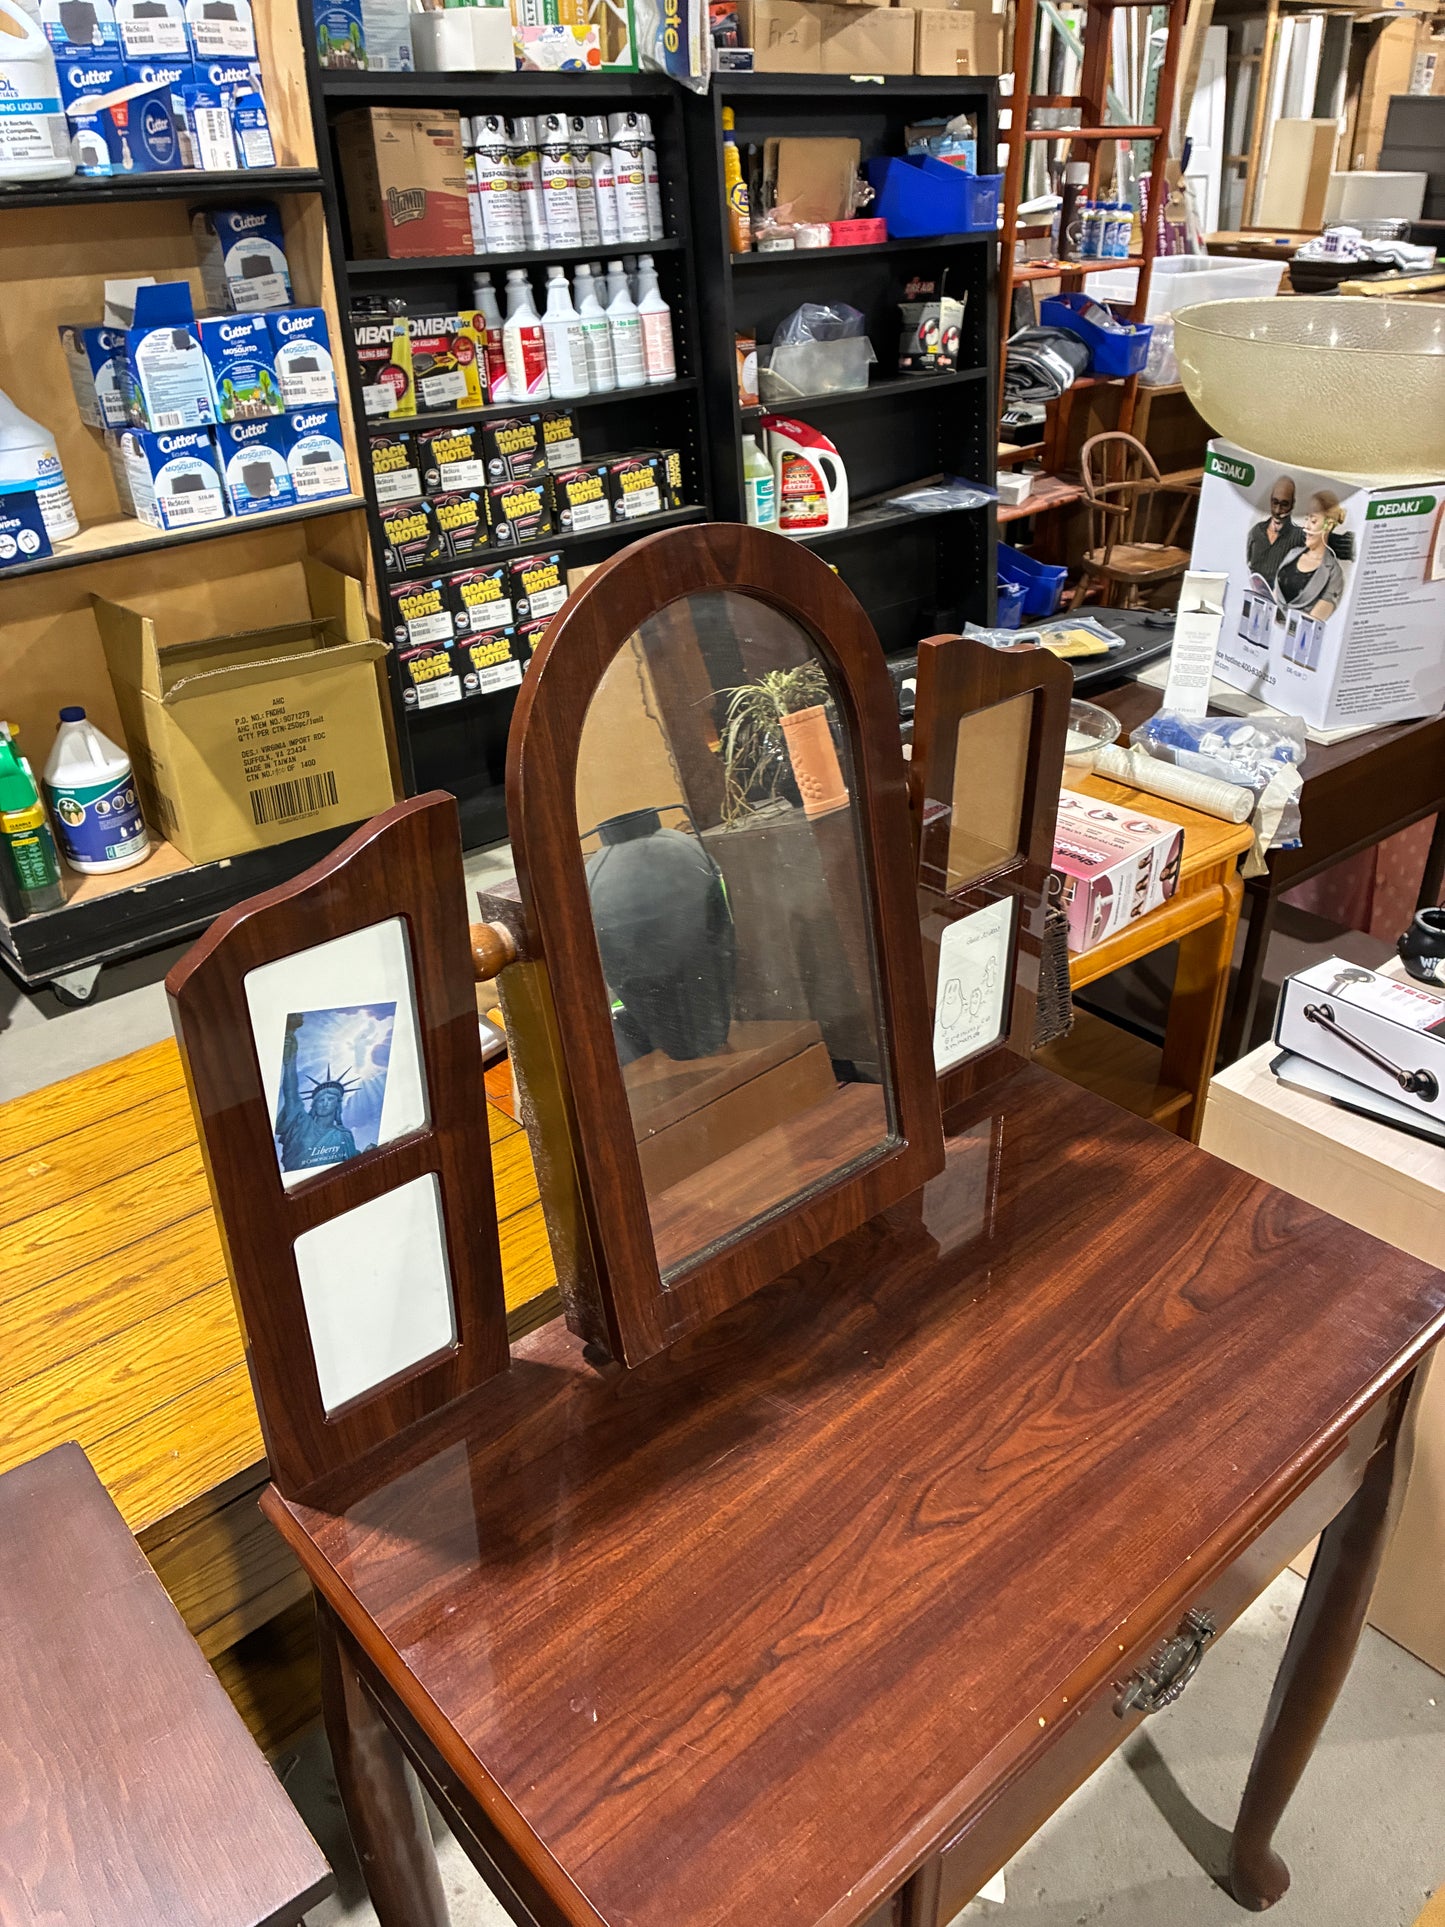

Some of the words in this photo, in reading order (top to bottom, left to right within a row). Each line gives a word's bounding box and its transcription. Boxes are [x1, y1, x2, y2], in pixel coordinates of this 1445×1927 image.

[69, 67, 113, 88] Cutter
[141, 67, 182, 84] Cutter
[209, 66, 250, 86] Cutter
[0, 80, 15, 91] OL
[17, 102, 44, 111] LIQUID
[146, 115, 169, 134] Cutter
[230, 214, 267, 232] Cutter
[220, 325, 252, 341] Cutter
[279, 316, 315, 335] Cutter
[354, 324, 395, 345] MBAT
[408, 317, 463, 337] OMBAT
[223, 345, 257, 355] MOSQUITO
[283, 344, 318, 354] MOSQUITO
[474, 341, 487, 388] COMBAT
[293, 413, 328, 431] Cutter
[543, 416, 572, 432] OACH
[231, 423, 268, 442] Cutter
[494, 425, 536, 443] ROACH
[160, 433, 198, 453] Cutter
[297, 439, 331, 449] MOSQUITO
[371, 444, 407, 461] OACH
[431, 434, 473, 453] ROACH
[499, 436, 538, 454] MOTEL
[236, 449, 272, 460] MOSQUITO
[435, 445, 474, 465] MOTEL
[165, 461, 202, 472] MOSQUITO
[668, 455, 676, 488] MOTEL
[673, 453, 682, 487] ROACH
[1210, 458, 1246, 480] DEDAKJ
[566, 476, 603, 496] ROACH
[620, 467, 654, 486] ROACH
[623, 477, 656, 493] MOTEL
[501, 490, 541, 508] ROACH
[570, 487, 604, 506] MOTEL
[436, 501, 478, 522] ROACH
[505, 500, 543, 519] MOTEL
[1376, 500, 1420, 516] DEDAKJ
[384, 513, 428, 534] ROACH
[440, 512, 480, 531] MOTEL
[388, 524, 430, 545] MOTEL
[521, 565, 559, 585] ROACH
[525, 575, 561, 594] MOTEL
[460, 577, 502, 598] ROACH
[398, 590, 441, 611] ROACH
[465, 587, 504, 608] MOTEL
[403, 600, 443, 620] MOTEL
[469, 638, 511, 659] ROACH
[408, 652, 450, 673] ROACH
[473, 649, 512, 669] MOTEL
[413, 662, 453, 684] MOTEL
[272, 697, 285, 706] AHC
[237, 724, 250, 733] AHC
[252, 720, 267, 730] ITEM
[283, 710, 310, 723] 9071279
[257, 728, 270, 737] PER
[261, 741, 286, 753] VIRGINIA
[289, 735, 310, 746] IMPORT
[313, 732, 326, 741] RDC
[275, 750, 284, 758] VA
[287, 745, 306, 756] 23434
[244, 764, 261, 774] MADE
[274, 755, 297, 767] TAIWAN
[246, 773, 259, 782] CTN
[287, 763, 295, 772] OF
[301, 758, 316, 768] 1400
[1056, 848, 1098, 866] Shark
